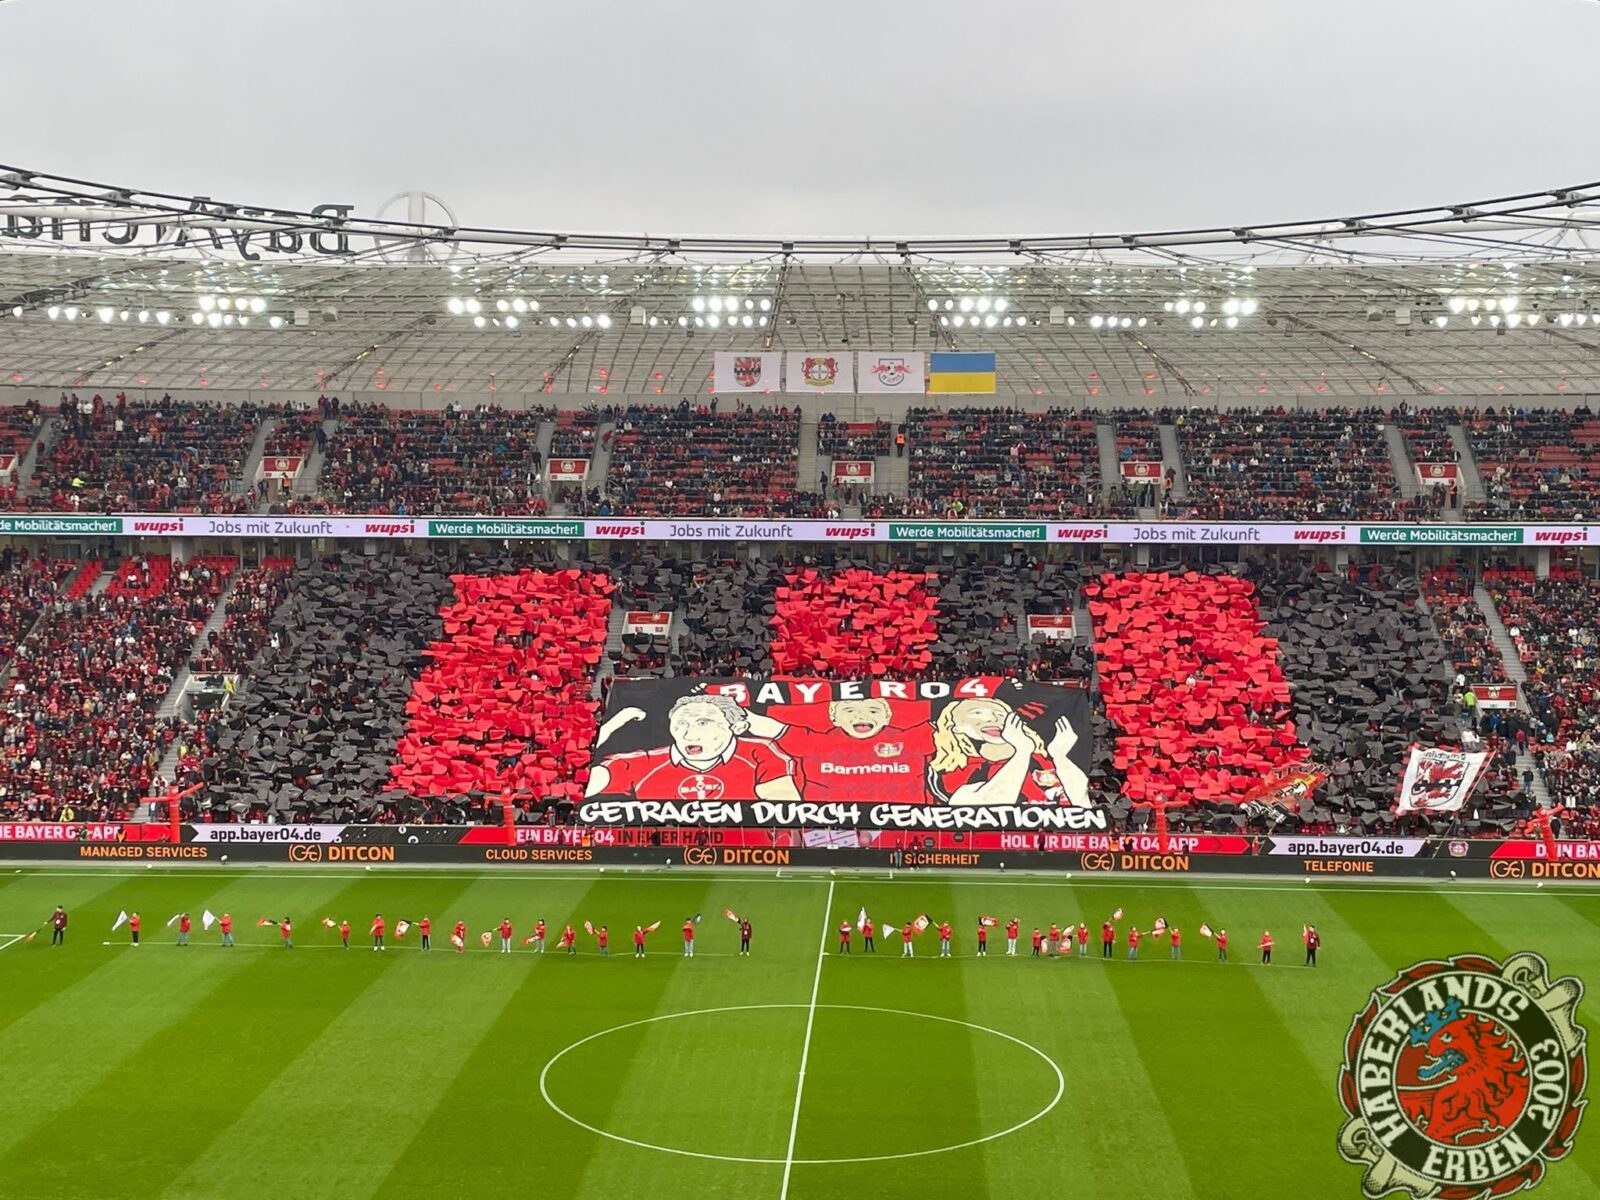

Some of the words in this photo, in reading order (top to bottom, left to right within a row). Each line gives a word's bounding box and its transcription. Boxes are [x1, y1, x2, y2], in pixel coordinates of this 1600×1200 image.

[15, 517, 117, 530] Mobilitätsmacher!
[134, 517, 184, 534] wupsi
[209, 520, 241, 534] Jobs
[246, 521, 270, 534] mit
[274, 520, 333, 534] Zukunft
[365, 519, 415, 535] wupsi
[435, 522, 473, 535] Werde
[476, 522, 579, 535] Mobilitätsmacher!
[595, 521, 645, 538] wupsi
[670, 524, 703, 537] Jobs
[707, 524, 731, 537] mit
[735, 524, 793, 537] Zukunft
[825, 522, 876, 539] wupsi
[895, 527, 934, 538] Werde
[937, 526, 1040, 538] Mobilitätsmacher!
[1057, 524, 1108, 541] wupsi
[1133, 528, 1168, 541] Jobs
[1171, 528, 1197, 541] mit
[1201, 527, 1260, 541] Zukunft
[1293, 525, 1346, 542] wupsi
[1367, 529, 1406, 541] Werde
[1410, 529, 1517, 542] Mobilitätsmacher!
[1535, 527, 1588, 544] wupsi
[820, 762, 910, 775] Barmenia
[579, 800, 744, 824] GETRAGEN
[751, 801, 862, 826] DURCH
[870, 803, 1107, 829] GENERATIONEN
[15, 825, 64, 839] BAYER
[210, 827, 321, 842] app.bayer04.de
[617, 831, 633, 844] IN
[1001, 834, 1030, 848] HOL
[1061, 835, 1086, 849] DIE
[1288, 840, 1404, 856] app.bayer04.de
[80, 846, 143, 858] MANAGED
[146, 846, 208, 858] SERVICES
[328, 847, 395, 860] DITCON
[485, 849, 528, 861] CLOUD
[531, 849, 593, 861] SERVICES
[723, 850, 790, 864] DITCON
[1121, 855, 1189, 870] DITCON
[1304, 860, 1374, 872] TELEFONIE
[1531, 862, 1600, 878] DITCON
